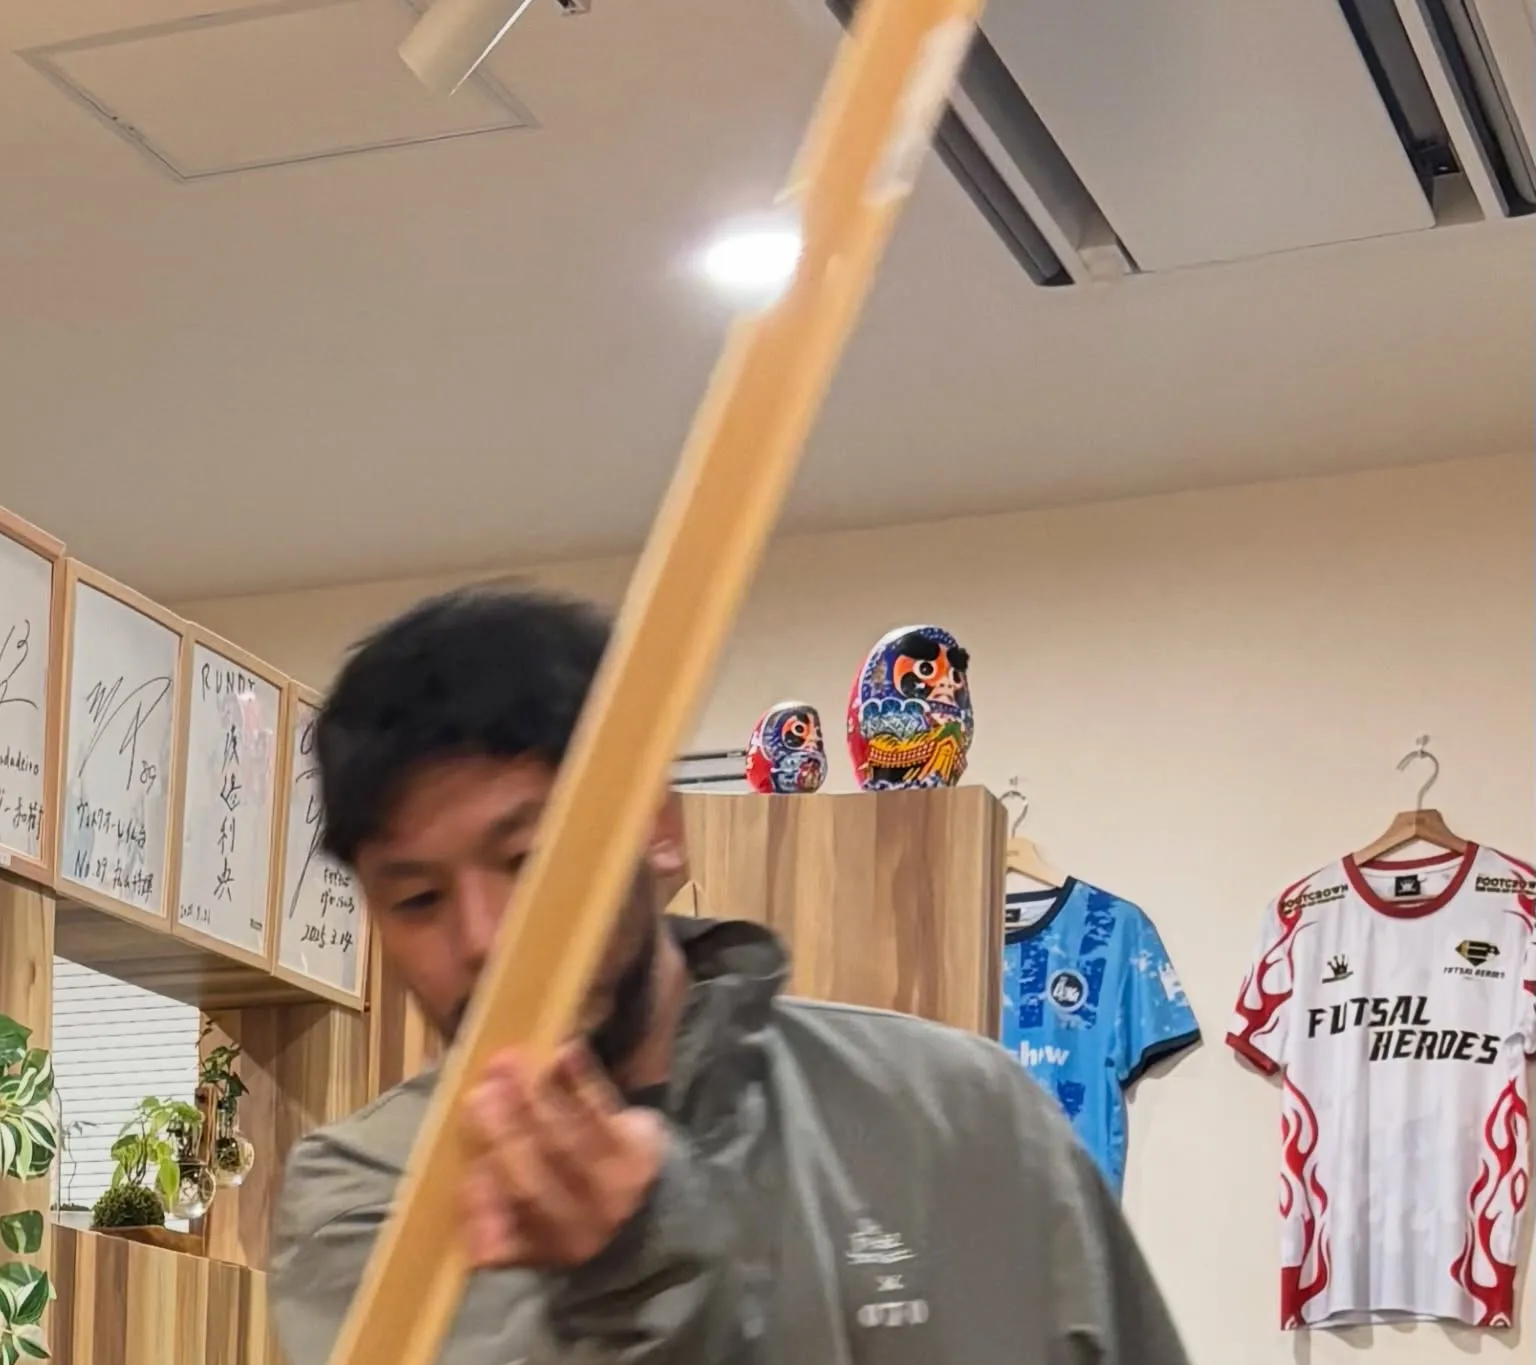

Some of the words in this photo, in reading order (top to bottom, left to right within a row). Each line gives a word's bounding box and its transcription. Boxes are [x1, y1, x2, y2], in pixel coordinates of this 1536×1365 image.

[1476, 875, 1536, 889] FOOTCROW
[1308, 996, 1431, 1040] FUTSAL
[1369, 1029, 1501, 1065] HEROES
